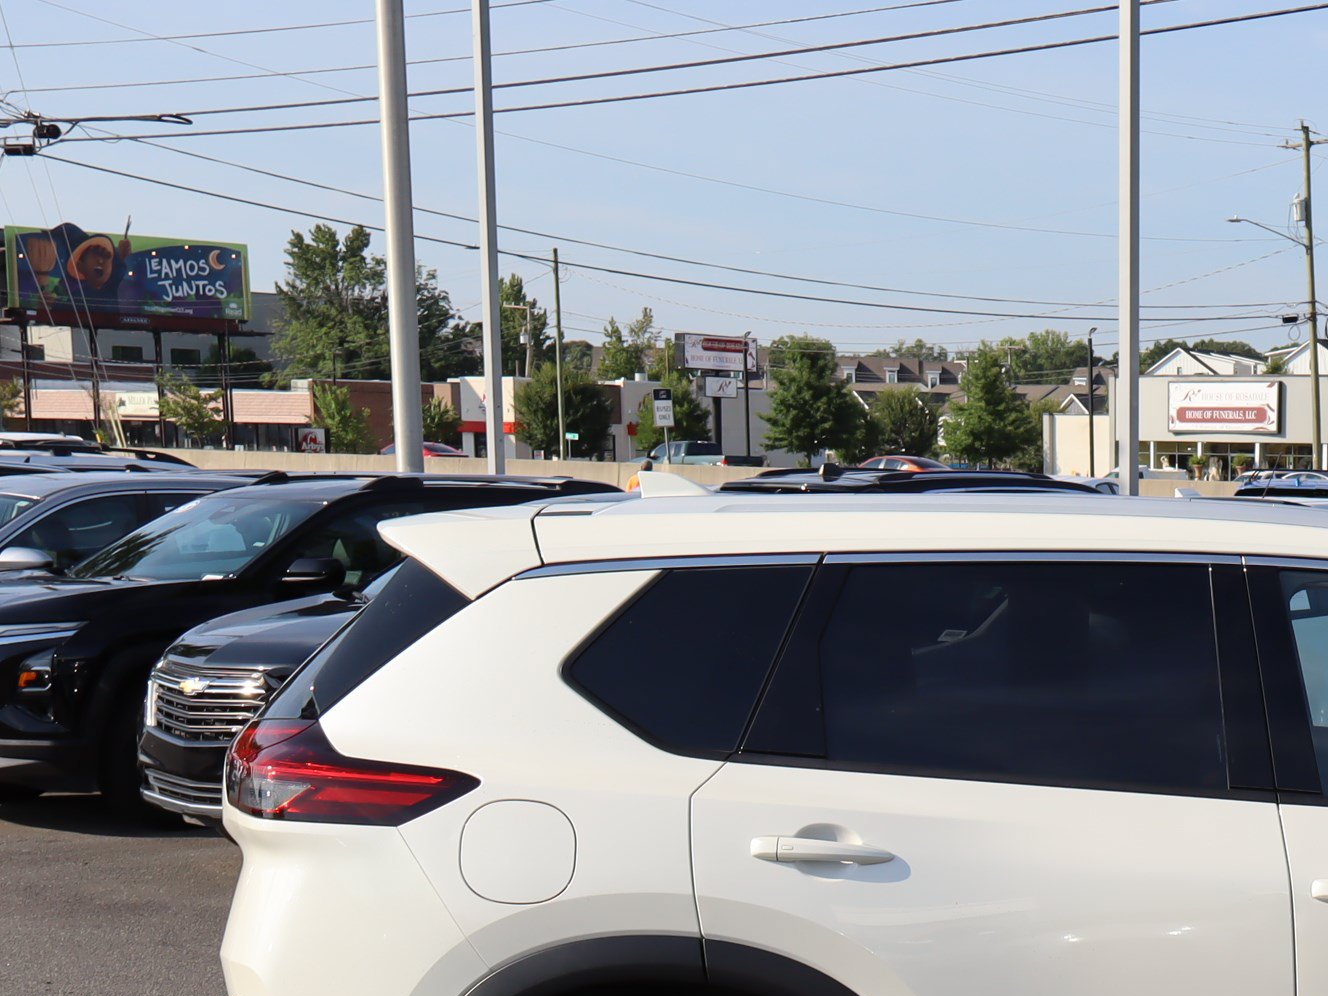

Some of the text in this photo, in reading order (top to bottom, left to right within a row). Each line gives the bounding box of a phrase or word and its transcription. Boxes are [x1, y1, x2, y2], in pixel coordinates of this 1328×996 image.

[1202, 392, 1222, 401] HOUSE
[1225, 392, 1234, 401] OF
[1185, 410, 1257, 420] HOME OF FUNERALS, LLC
